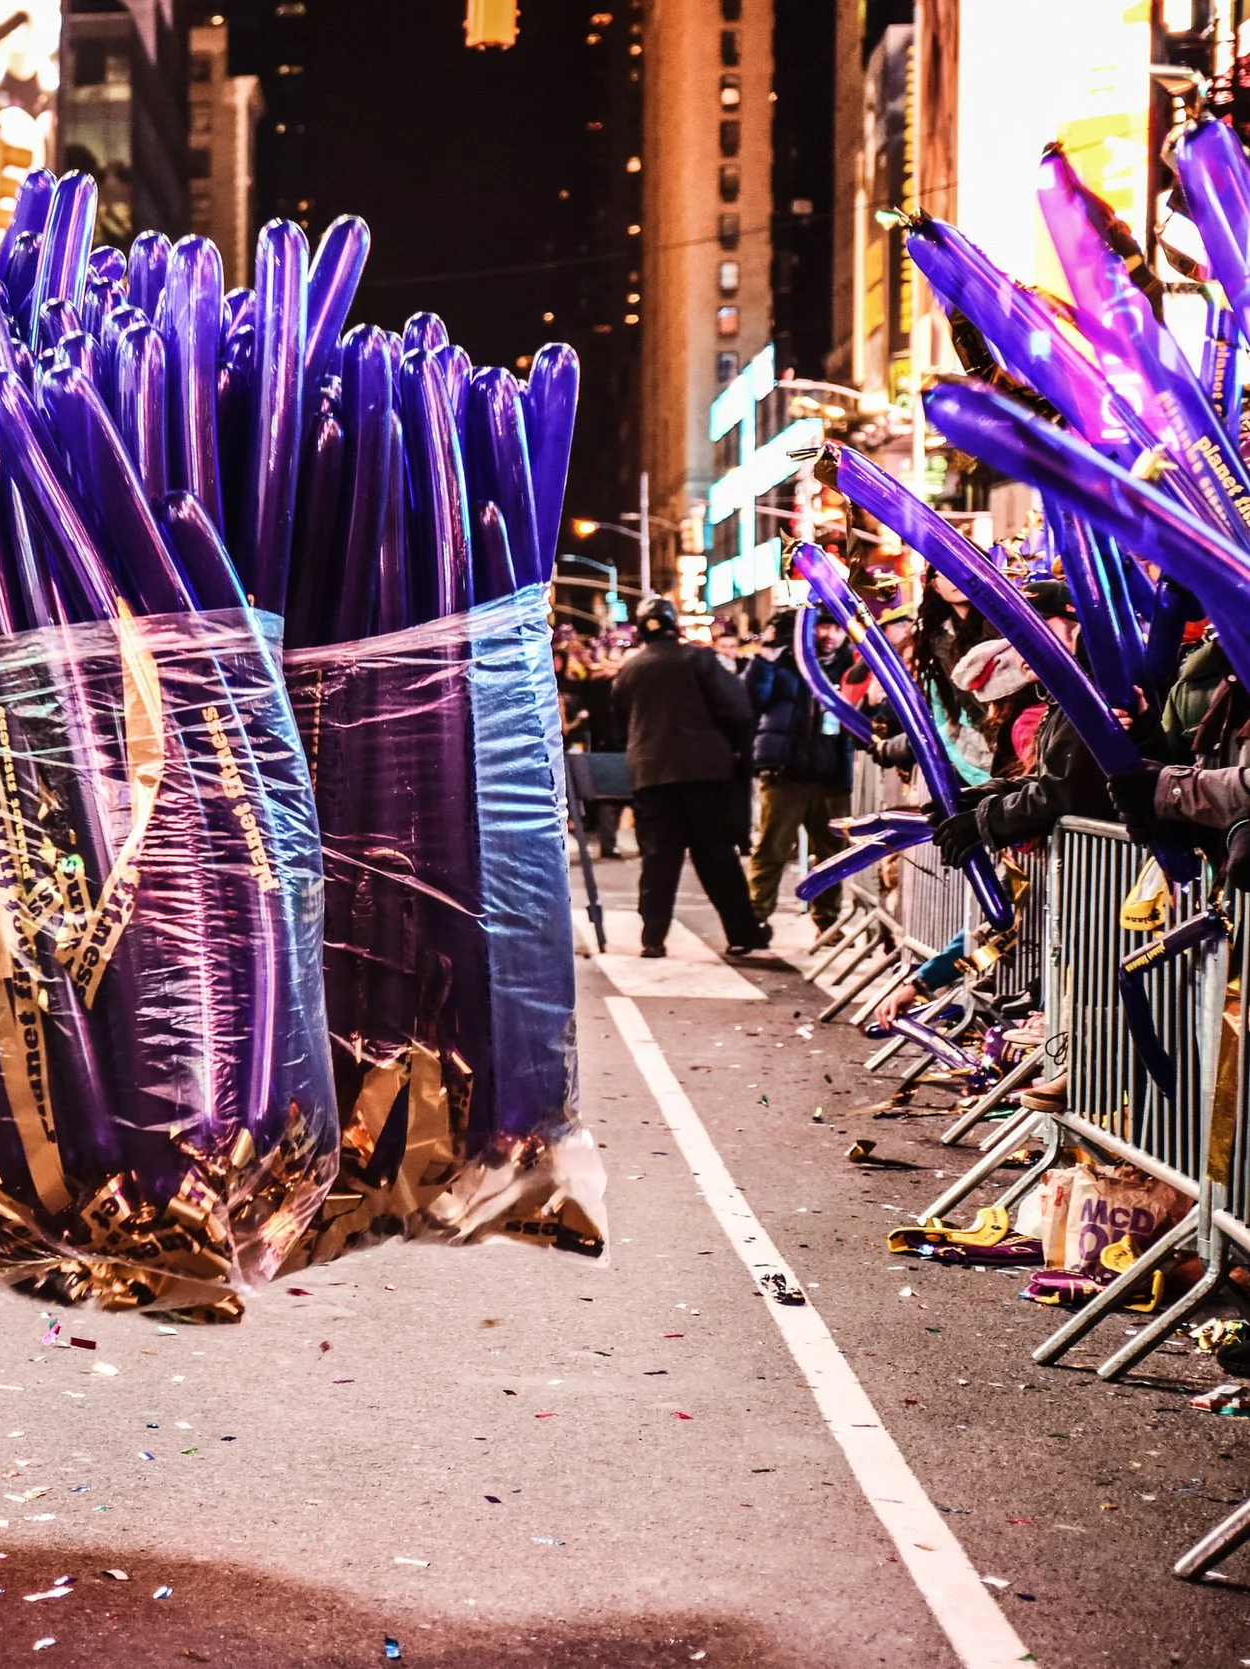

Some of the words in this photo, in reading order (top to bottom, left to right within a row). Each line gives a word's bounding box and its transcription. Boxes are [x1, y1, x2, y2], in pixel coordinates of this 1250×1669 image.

[1191, 435, 1245, 497] planet
[202, 706, 247, 799] fitness
[232, 802, 280, 893] planet
[1081, 1198, 1155, 1232] McD
